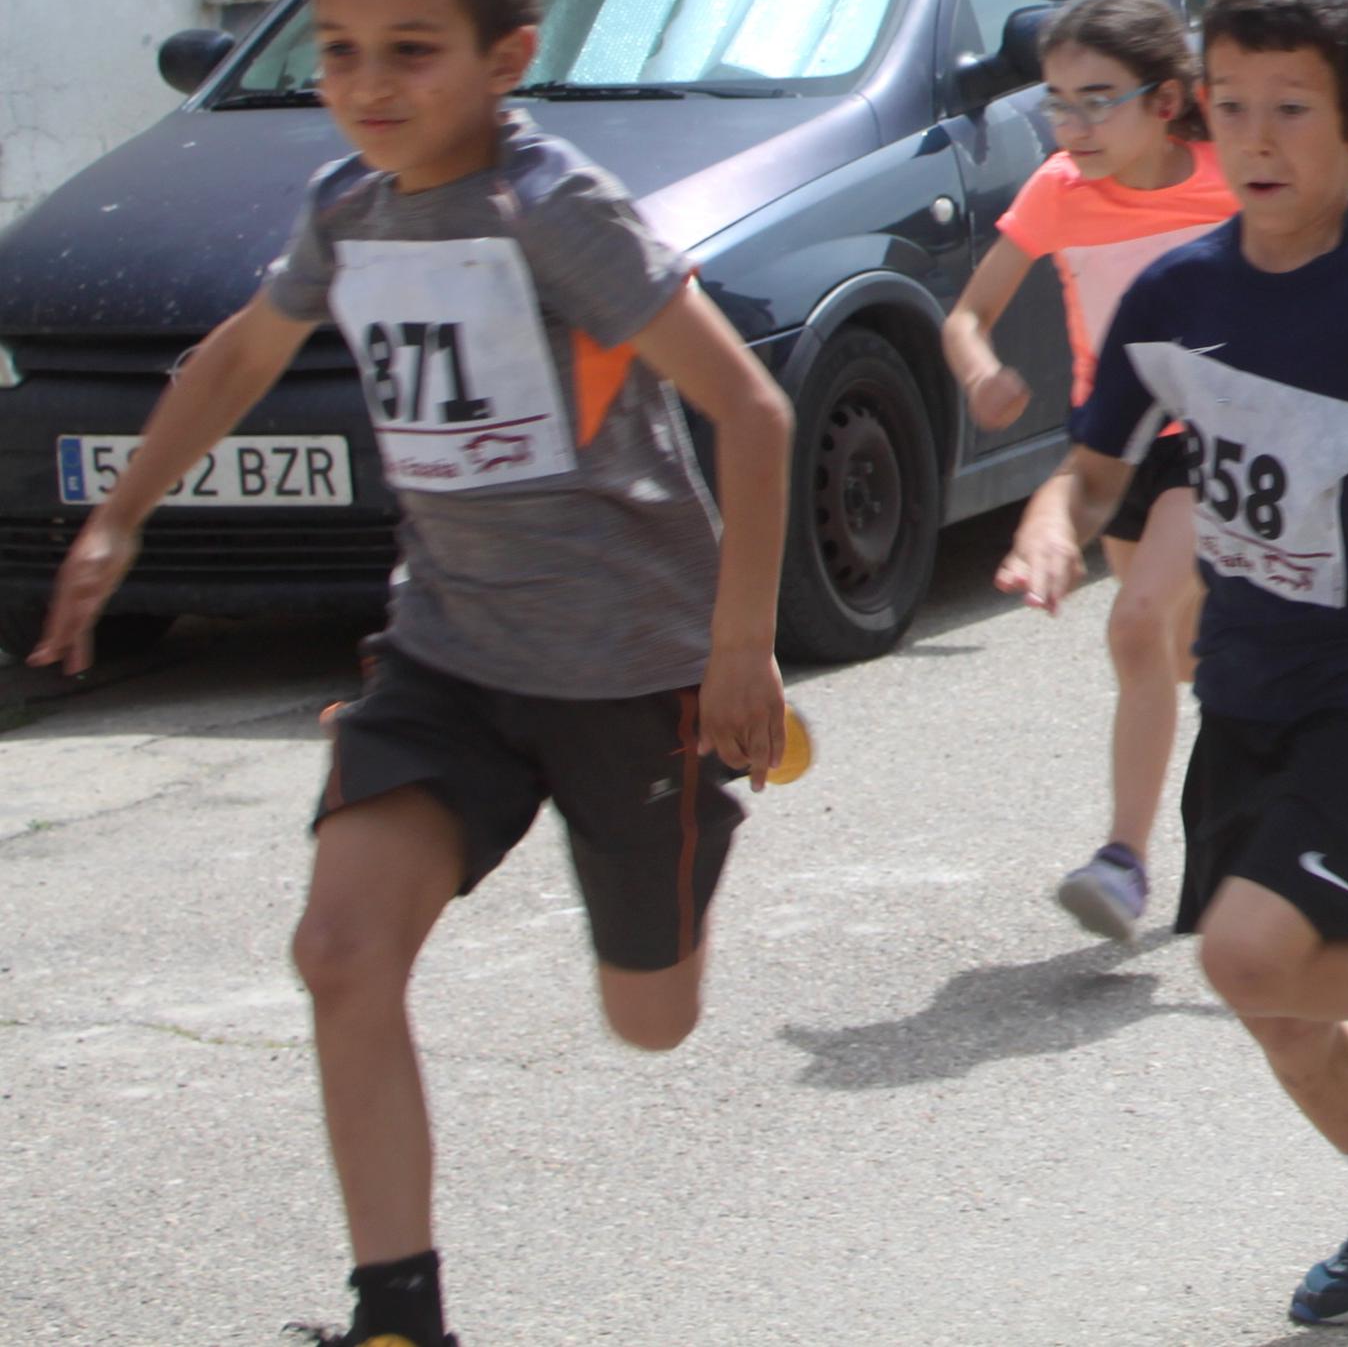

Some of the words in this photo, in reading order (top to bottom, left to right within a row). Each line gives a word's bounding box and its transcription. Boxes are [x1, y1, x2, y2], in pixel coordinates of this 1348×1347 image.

[365, 321, 494, 424] 871
[91, 447, 219, 496] 52
[237, 448, 336, 497] BZR
